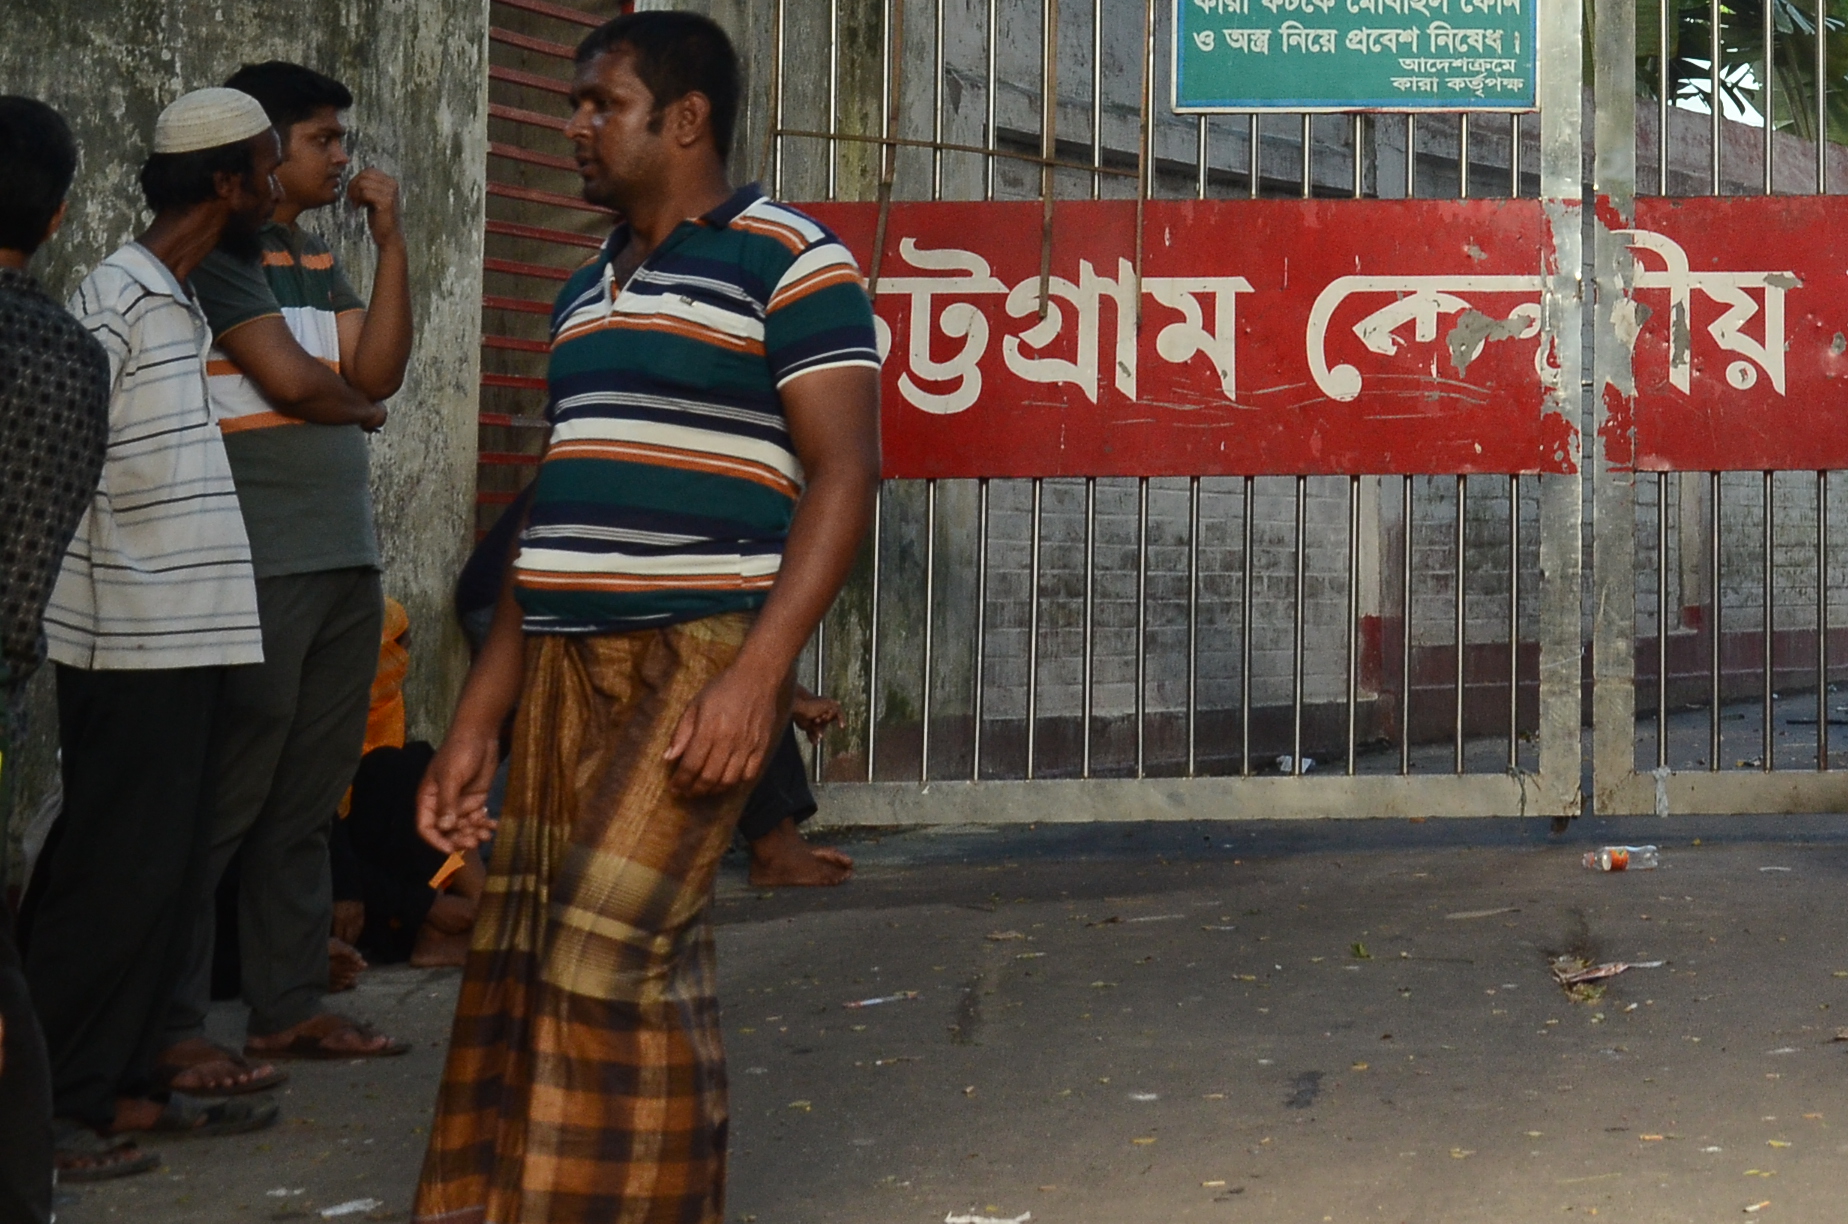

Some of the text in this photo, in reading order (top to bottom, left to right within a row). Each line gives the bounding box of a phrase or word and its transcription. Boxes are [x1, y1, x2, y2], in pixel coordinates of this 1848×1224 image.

[1193, 31, 1216, 52] ও
[1223, 26, 1273, 56] অস্ত্র
[1279, 20, 1338, 54] নিয়ে
[1345, 25, 1420, 55] প্রবেশ
[1398, 56, 1517, 74] আদেশক্রমে
[1390, 71, 1525, 98] কারা কর্তৃপক্ষ
[864, 237, 1255, 415] ট্টগ্রাম
